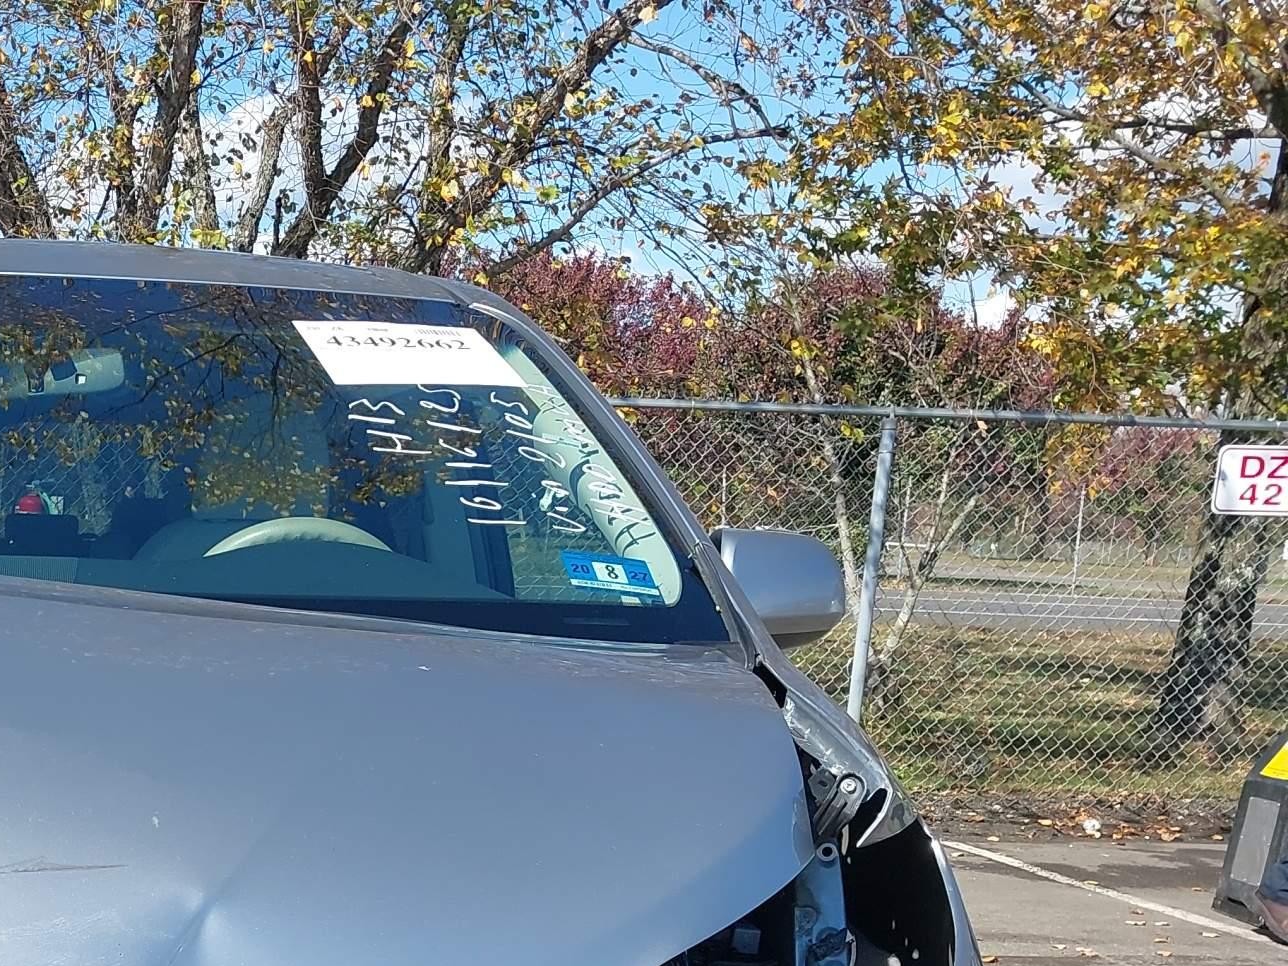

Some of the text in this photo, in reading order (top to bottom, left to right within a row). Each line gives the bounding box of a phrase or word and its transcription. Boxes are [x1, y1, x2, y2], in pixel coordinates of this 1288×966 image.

[326, 335, 472, 350] 43492662
[348, 398, 433, 455] H13
[1239, 455, 1288, 479] DZ
[1238, 483, 1283, 506] 42
[571, 563, 649, 582] 20 8 27
